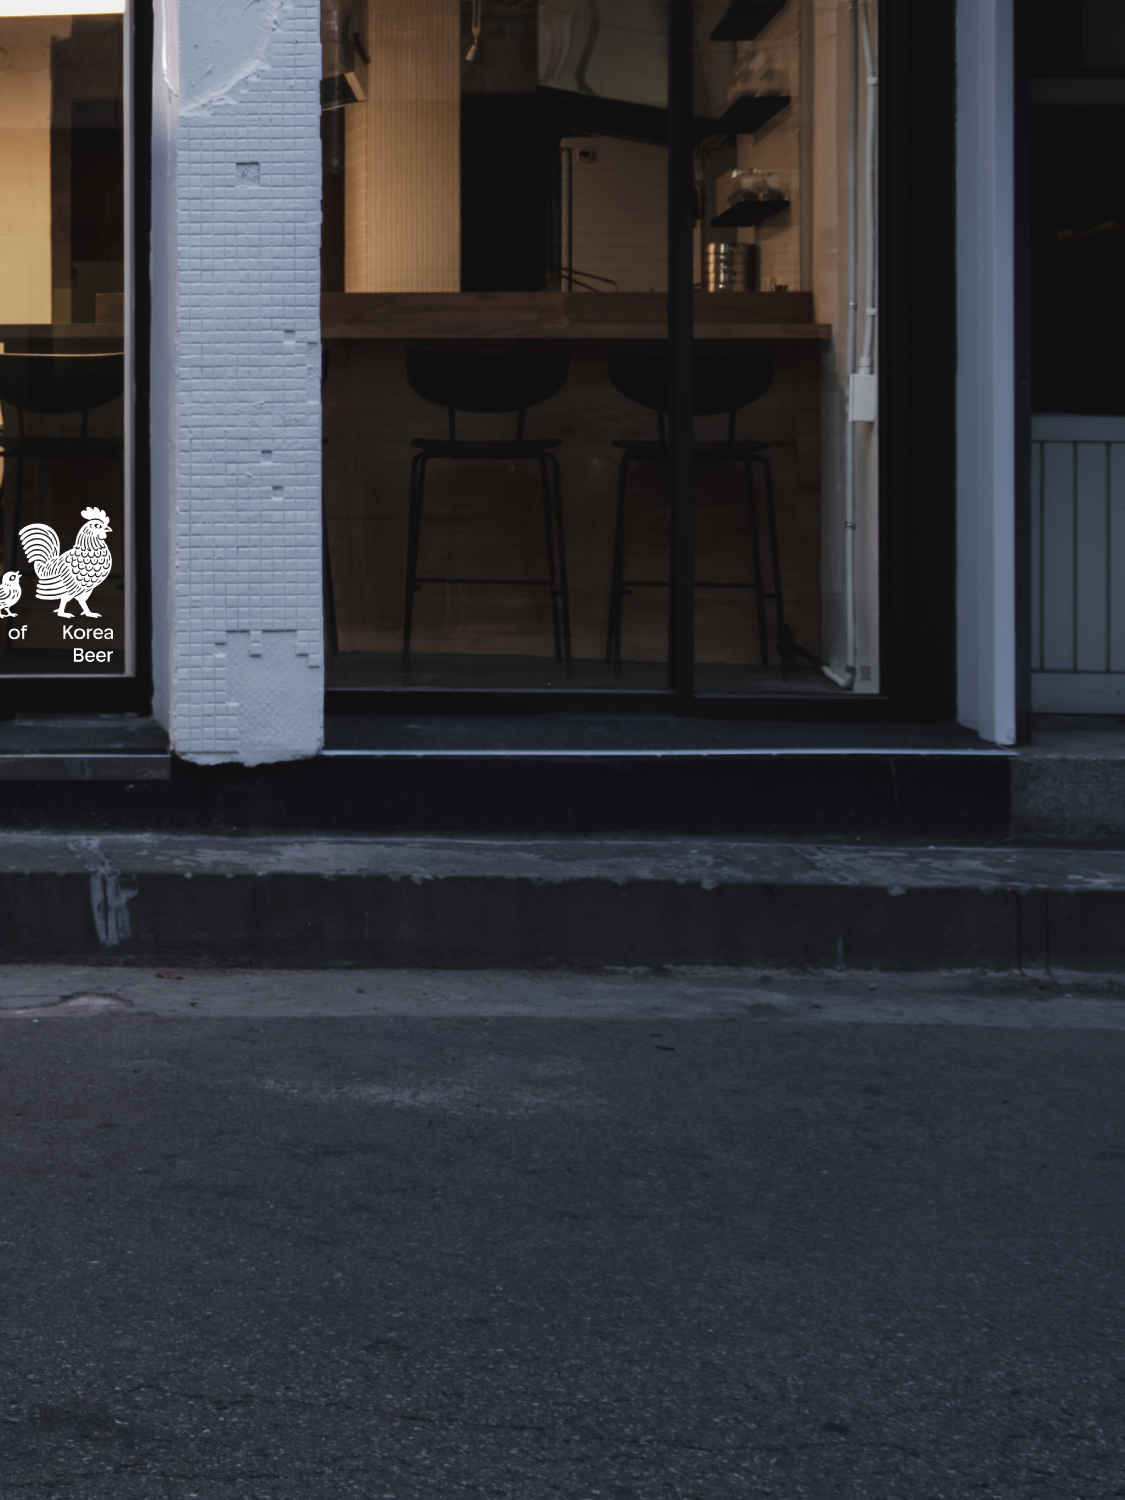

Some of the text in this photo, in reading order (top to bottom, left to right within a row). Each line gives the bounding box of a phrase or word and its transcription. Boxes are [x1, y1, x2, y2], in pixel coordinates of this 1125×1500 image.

[7, 624, 28, 641] of
[62, 624, 115, 641] Korea
[73, 647, 114, 664] Beer
